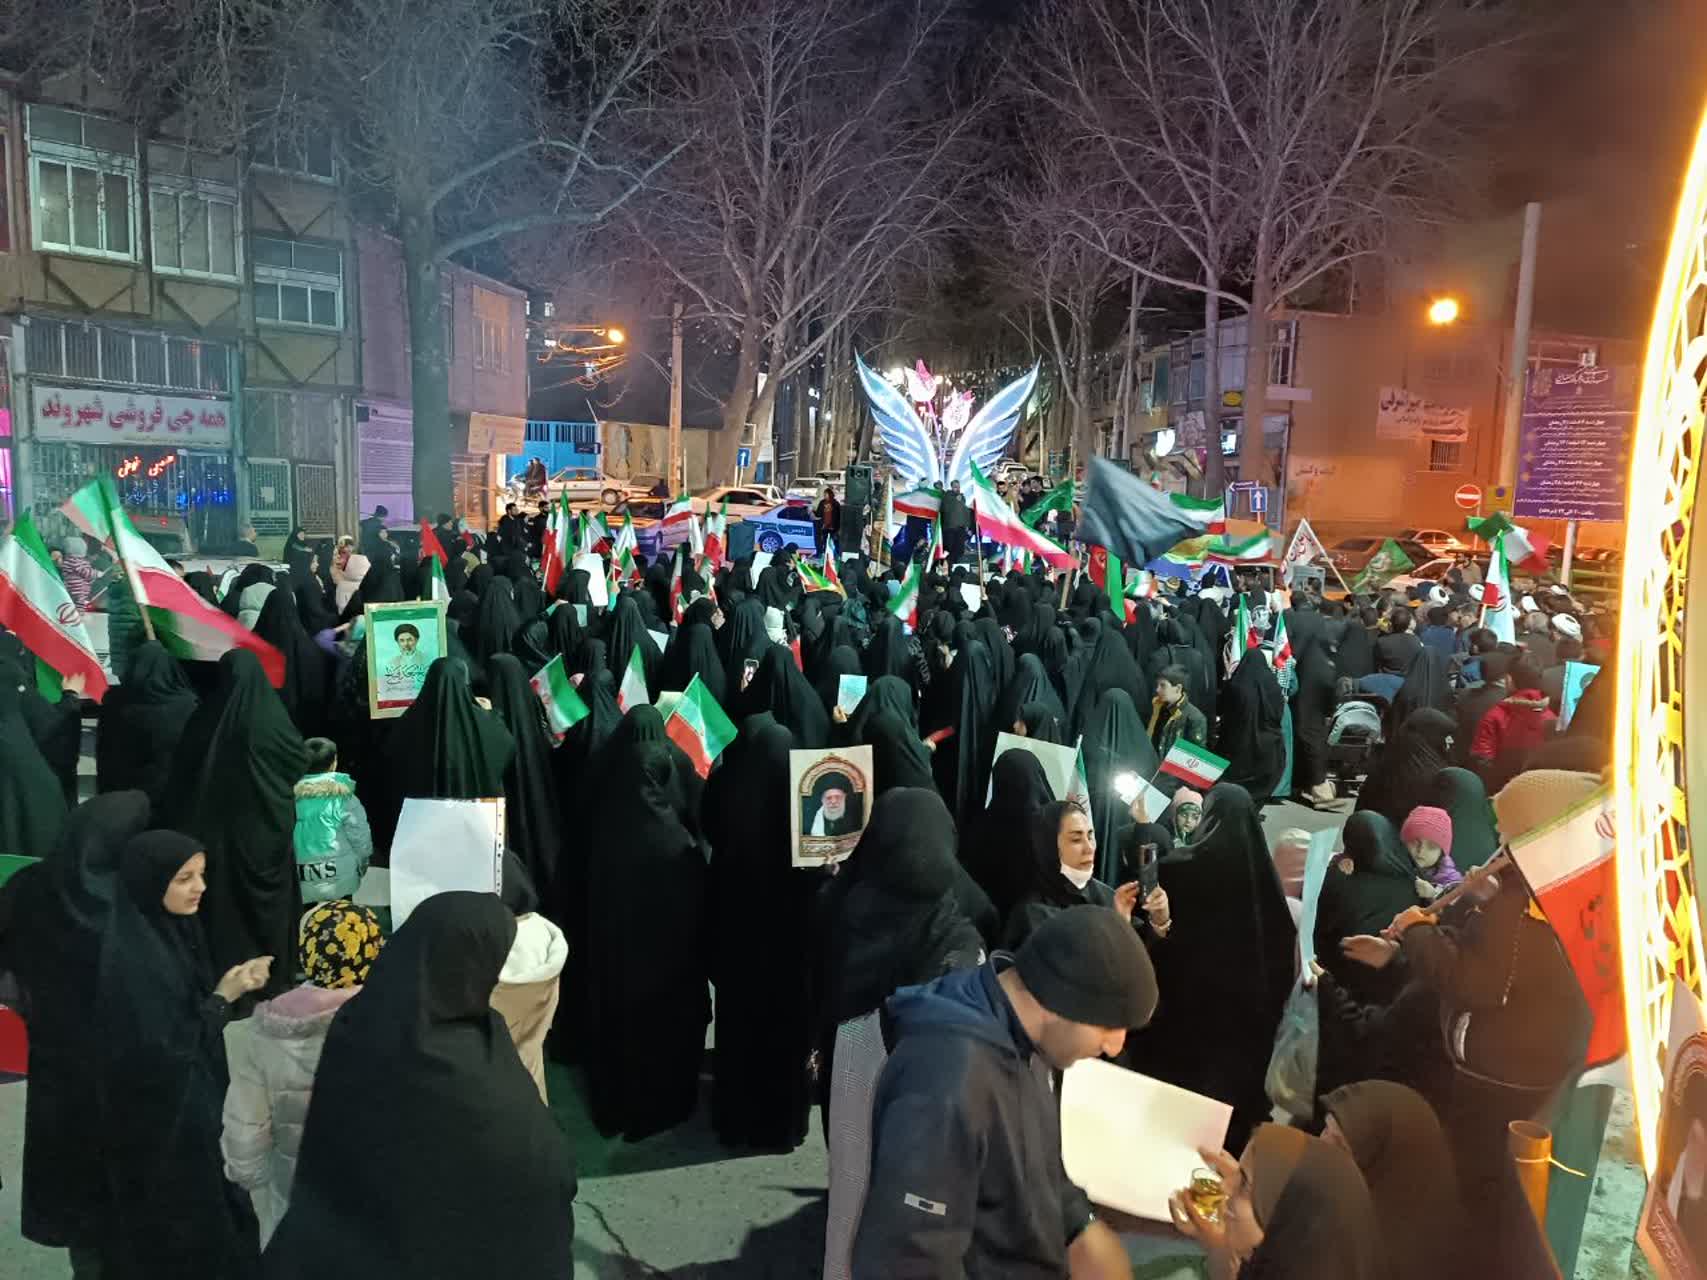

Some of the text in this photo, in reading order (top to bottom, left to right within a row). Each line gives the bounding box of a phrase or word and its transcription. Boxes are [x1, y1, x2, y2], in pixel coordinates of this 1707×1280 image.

[42, 391, 104, 427] شهروند
[107, 396, 163, 432] فروشی
[168, 408, 194, 434] چی
